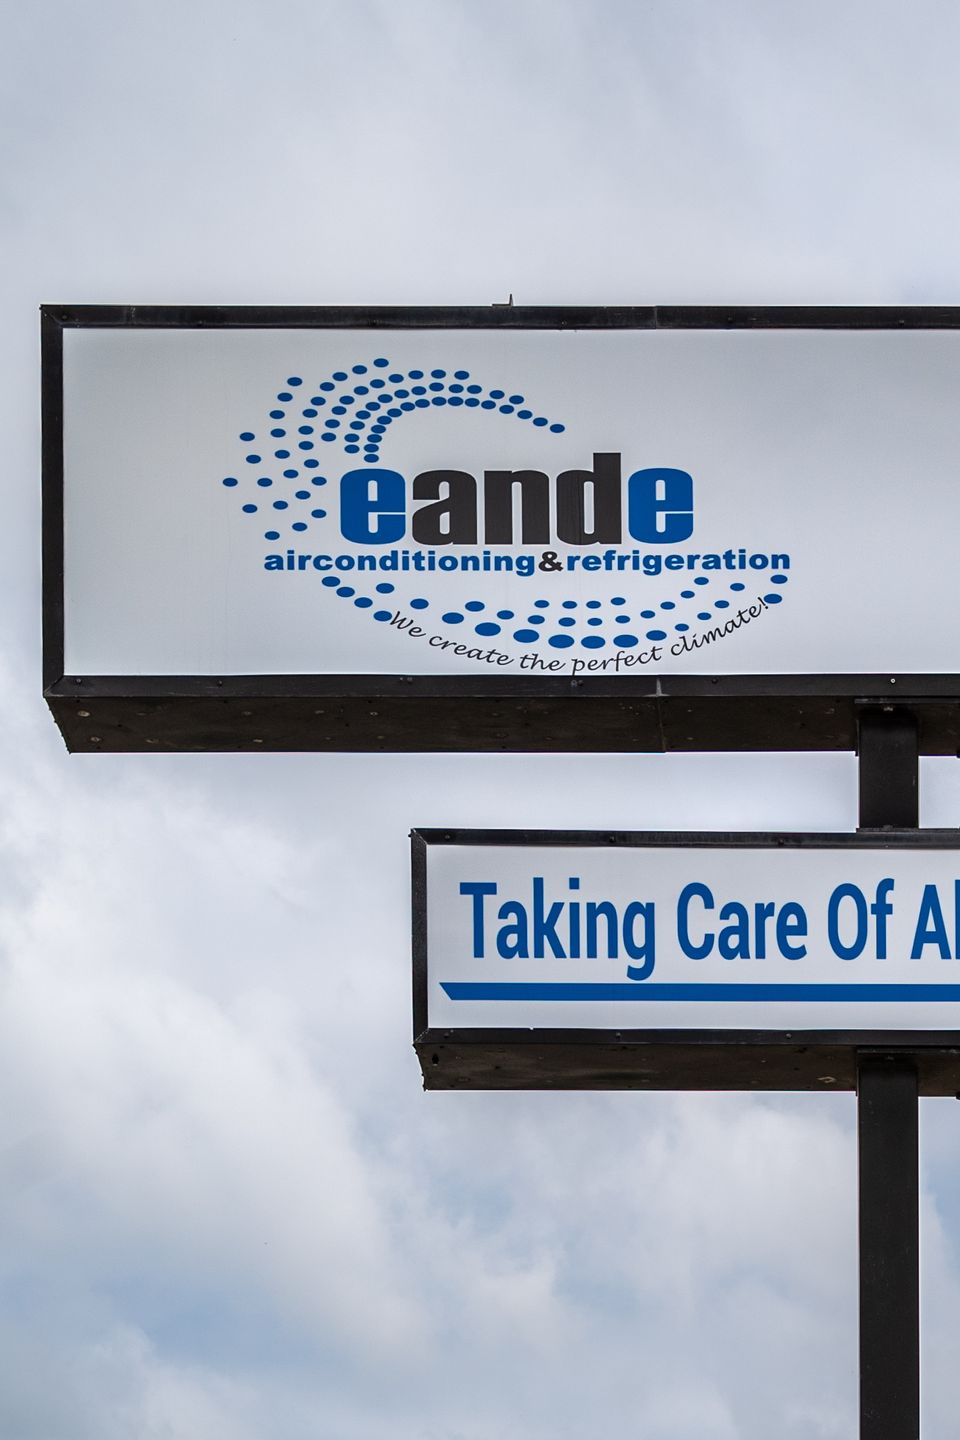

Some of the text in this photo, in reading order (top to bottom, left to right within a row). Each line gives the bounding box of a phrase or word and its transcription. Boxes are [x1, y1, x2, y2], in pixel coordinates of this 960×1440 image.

[340, 453, 694, 546] eande
[389, 596, 770, 676] We create the perfect climate!
[459, 877, 656, 981] Taking
[676, 882, 808, 961] Care
[827, 878, 895, 961] Of
